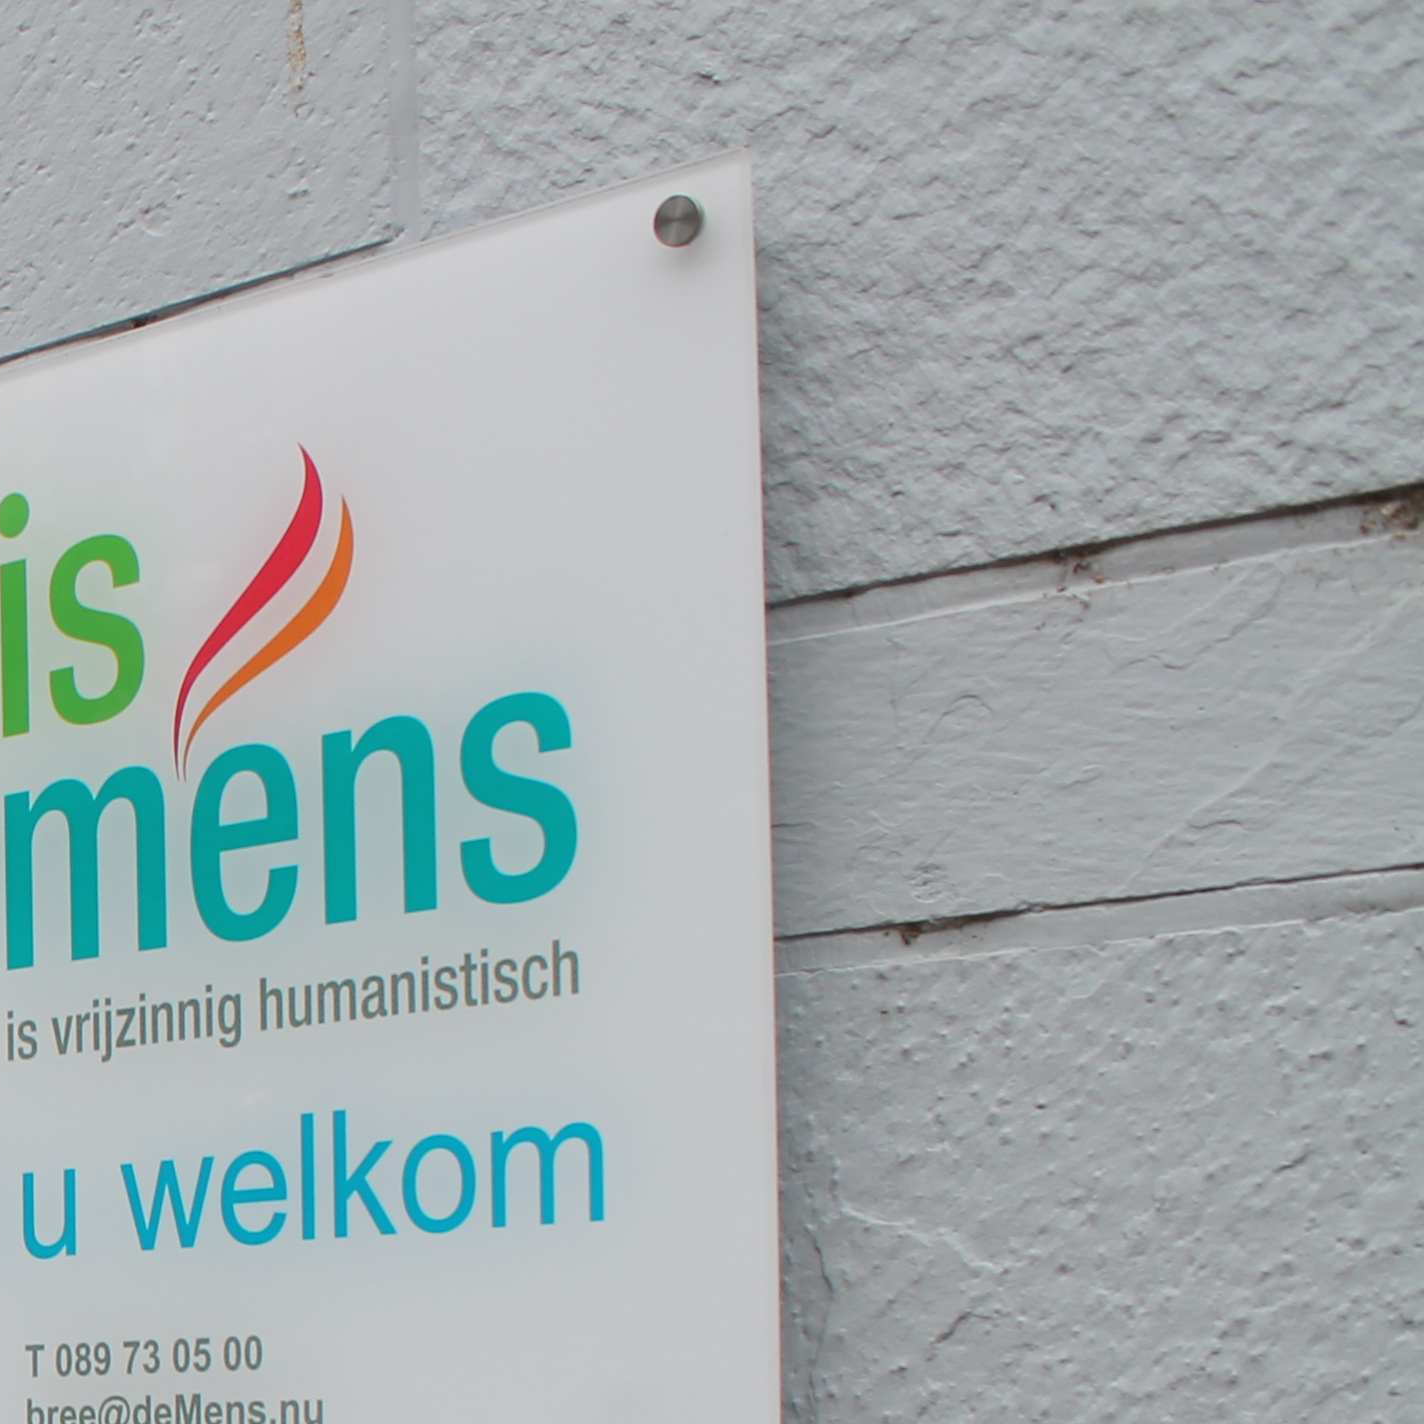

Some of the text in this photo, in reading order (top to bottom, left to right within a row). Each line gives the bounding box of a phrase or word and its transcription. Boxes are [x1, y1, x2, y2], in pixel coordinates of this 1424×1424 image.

[1, 691, 579, 970] mens
[6, 939, 580, 1063] is vrijzinnig humanistisch
[22, 1168, 77, 1260] u
[120, 1109, 605, 1251] welkom
[24, 1335, 263, 1378] T 089 73 05 00
